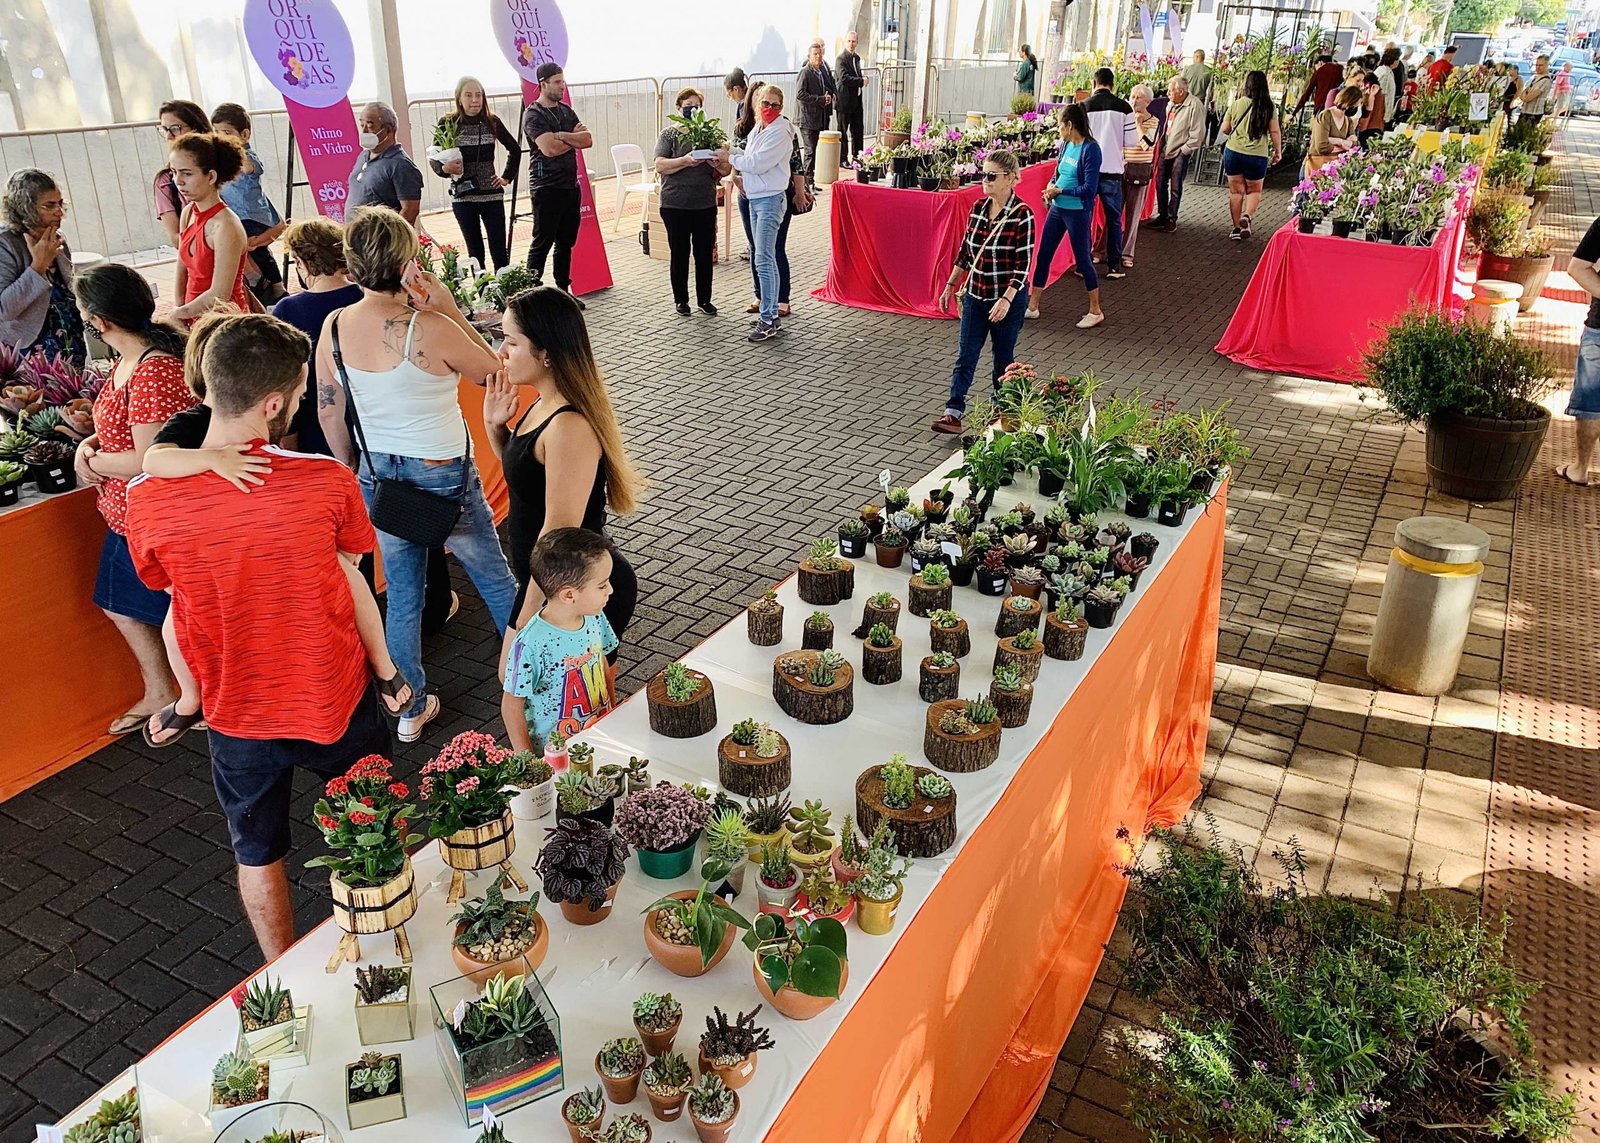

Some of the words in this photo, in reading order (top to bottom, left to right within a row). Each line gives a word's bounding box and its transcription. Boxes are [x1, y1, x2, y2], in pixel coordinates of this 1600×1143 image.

[268, 0, 302, 18] OR
[507, 0, 532, 12] OR
[526, 30, 550, 47] DE
[295, 42, 329, 62] DE
[536, 48, 555, 66] AS
[310, 64, 336, 85] AS
[309, 127, 343, 140] Mimo
[308, 144, 321, 157] in
[322, 142, 353, 156] Vidro
